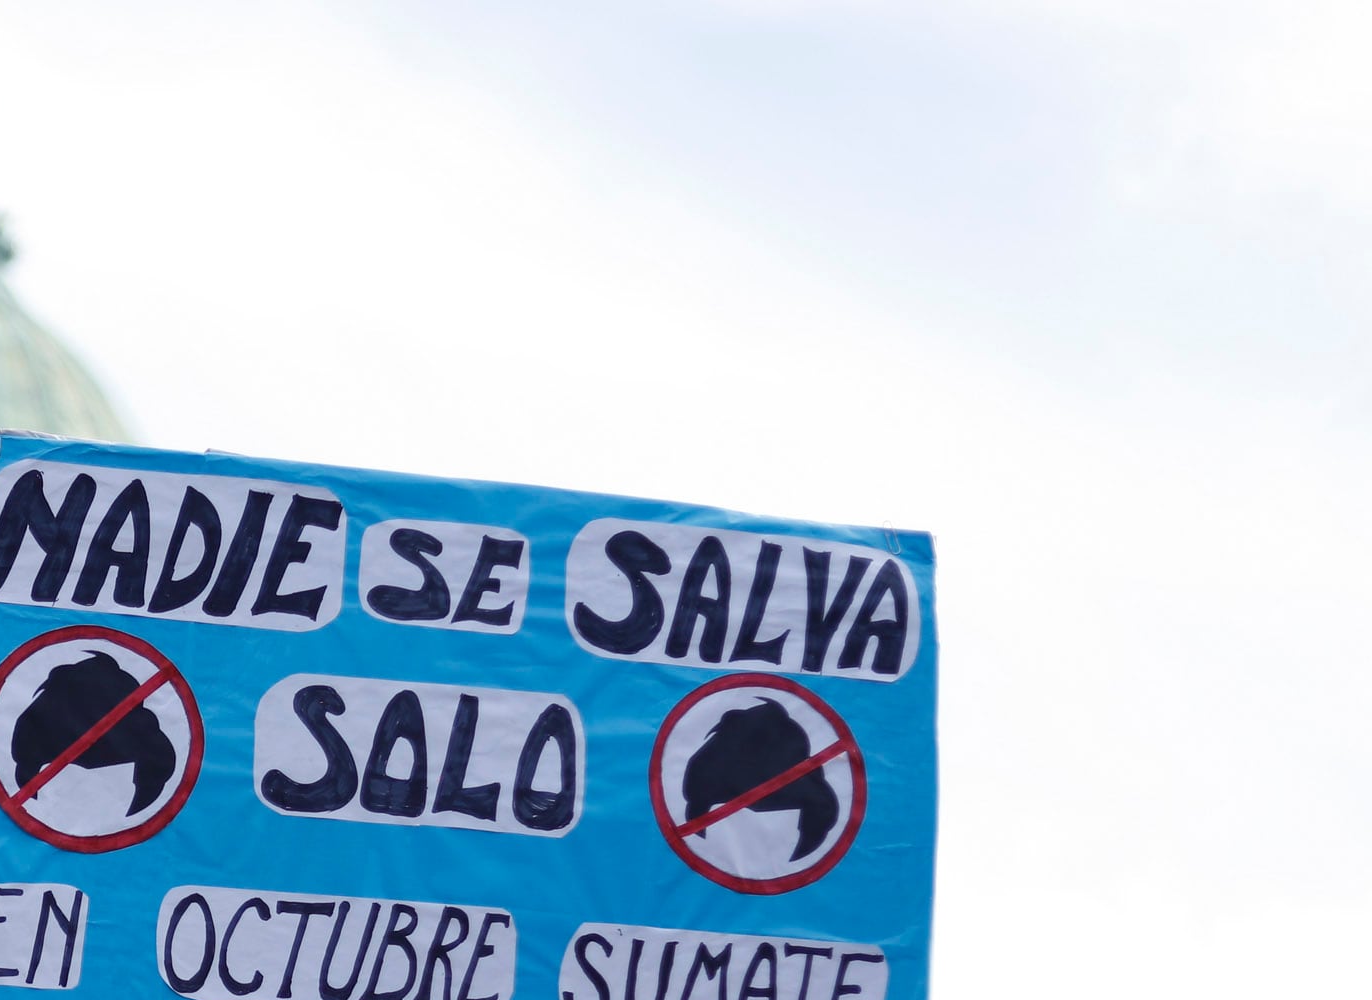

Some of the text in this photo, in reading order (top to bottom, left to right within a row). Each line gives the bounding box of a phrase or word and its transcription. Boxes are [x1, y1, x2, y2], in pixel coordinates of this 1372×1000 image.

[366, 527, 524, 626] SE
[574, 529, 909, 675] SALVA
[260, 684, 577, 831] SOLO
